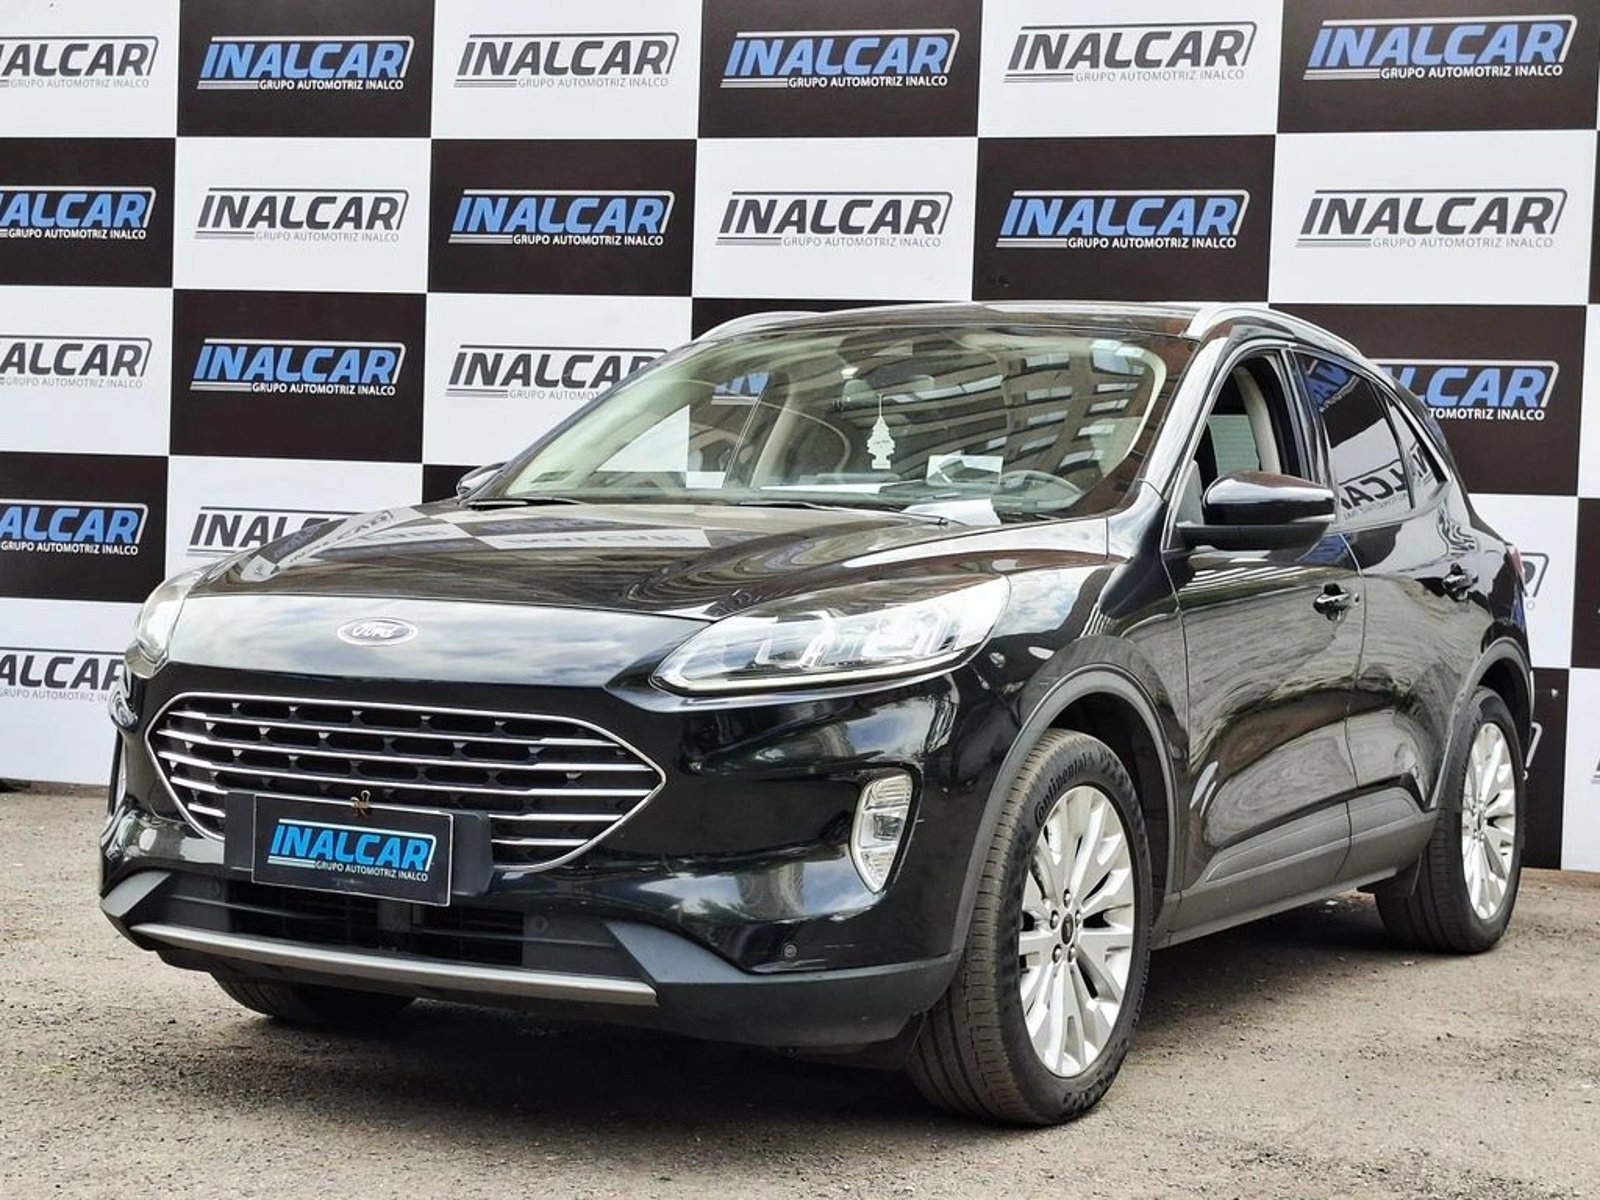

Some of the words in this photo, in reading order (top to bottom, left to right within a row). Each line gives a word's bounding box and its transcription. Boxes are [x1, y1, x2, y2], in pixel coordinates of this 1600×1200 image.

[1008, 30, 1245, 70] INALCAR
[1308, 24, 1564, 67] INALCAR
[0, 43, 149, 76] ALCAR
[200, 43, 404, 78] INALCAR
[458, 40, 669, 76] INALCAR
[724, 37, 949, 76] INALCAR
[1075, 72, 1116, 82] GRUPO
[1120, 71, 1197, 82] AUTOMOTRIZ
[1199, 70, 1244, 80] INALCO
[1381, 67, 1425, 79] GRUPO
[1428, 66, 1511, 78] AUTOMOTRIZ
[1514, 65, 1563, 77] INALCO
[10, 79, 44, 88] GRUPO
[46, 79, 111, 88] AUTOMOTRIZ
[113, 79, 149, 88] INALCO
[259, 80, 295, 90] GRUPO
[297, 80, 363, 90] AUTOMOTRIZ
[366, 80, 403, 90] INALCO
[518, 78, 555, 88] GRUPO
[559, 78, 626, 88] AUTOMOTRIZ
[629, 78, 668, 87] INALCO
[789, 77, 828, 88] GRUPO
[830, 77, 902, 87] AUTOMOTRIZ
[906, 75, 948, 86] INALCO
[0, 193, 147, 227] ALCAR
[198, 195, 400, 230] INALCAR
[452, 197, 664, 233] INALCAR
[719, 199, 941, 235] INALCAR
[1000, 198, 1238, 236] INALCAR
[1300, 197, 1554, 235] INALCAR
[9, 229, 42, 239] GRUPO
[44, 229, 108, 239] AUTOMOTRIZ
[110, 229, 147, 239] INALCO
[255, 231, 291, 241] GRUPO
[294, 231, 359, 241] AUTOMOTRIZ
[361, 232, 399, 242] INALCO
[513, 234, 550, 245] GRUPO
[553, 235, 621, 245] AUTOMOTRIZ
[624, 235, 664, 246] INALCO
[784, 237, 822, 247] GRUPO
[825, 237, 896, 248] AUTOMOTRIZ
[899, 237, 941, 248] INALCO
[1068, 237, 1109, 248] GRUPO
[1112, 237, 1189, 248] AUTOMOTRIZ
[1192, 238, 1237, 249] INALCO
[1373, 237, 1416, 248] GRUPO
[1420, 237, 1503, 248] AUTOMOTRIZ
[1506, 238, 1553, 248] INALCO
[193, 346, 396, 384] INALCAR
[6, 378, 39, 386] GRUPO
[41, 378, 106, 388] AUTOMOTRIZ
[108, 379, 143, 388] INALCO
[252, 382, 287, 393] GRUPO
[290, 383, 355, 395] AUTOMOTRIZ
[358, 385, 396, 396] INALCO
[509, 390, 545, 399] GRUPO
[1429, 408, 1494, 419] TOMOTRIZ
[1497, 408, 1545, 421] INALCO
[1, 541, 34, 551] GRUPO
[37, 542, 100, 554] AUTOMOTRIZ
[102, 544, 139, 556] INALCO
[270, 824, 432, 871] INALCAR
[316, 860, 344, 873] GRUPO
[345, 864, 397, 878] AUTOMOTRIZ
[398, 870, 429, 883] INALCO
